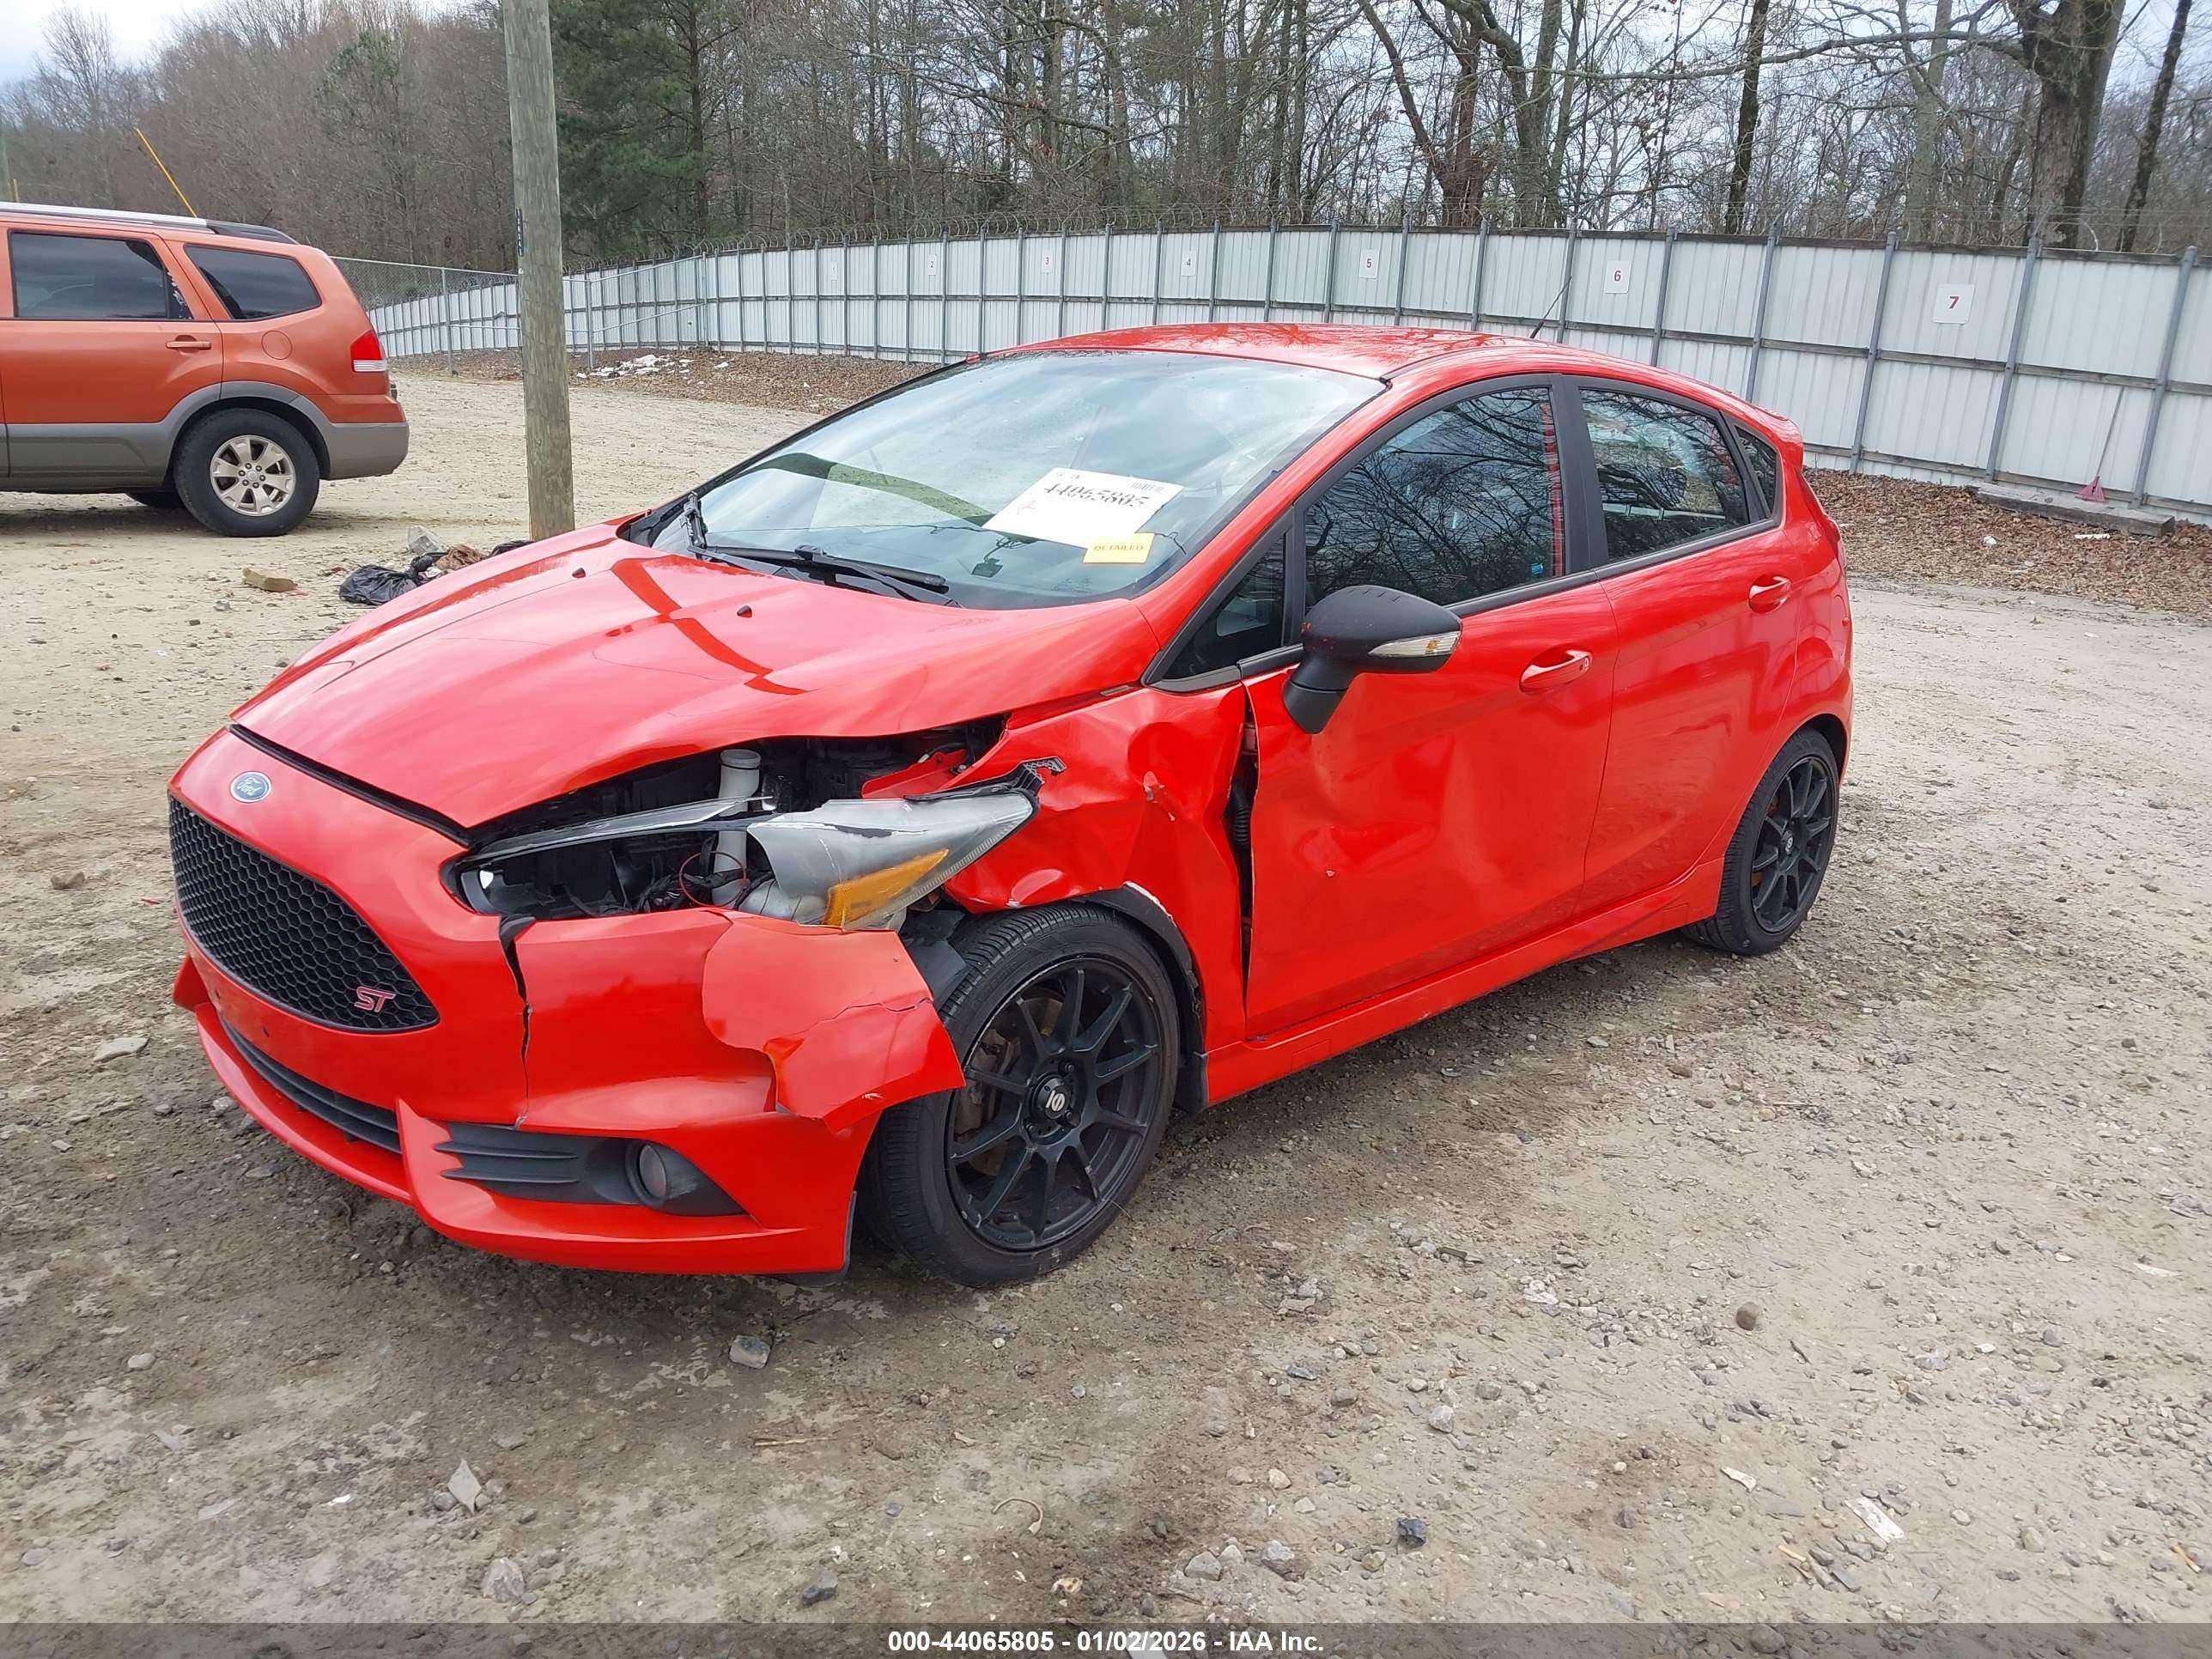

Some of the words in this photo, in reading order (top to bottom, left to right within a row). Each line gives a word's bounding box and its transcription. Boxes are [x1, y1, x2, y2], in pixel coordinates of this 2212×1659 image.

[930, 260, 934, 269] 2
[1045, 257, 1050, 265] 3
[1186, 258, 1192, 267] 4
[1366, 258, 1373, 269] 5
[1613, 270, 1622, 283] 6
[1948, 295, 1960, 310] 7
[236, 777, 262, 796] Ford
[353, 986, 397, 1013] ST
